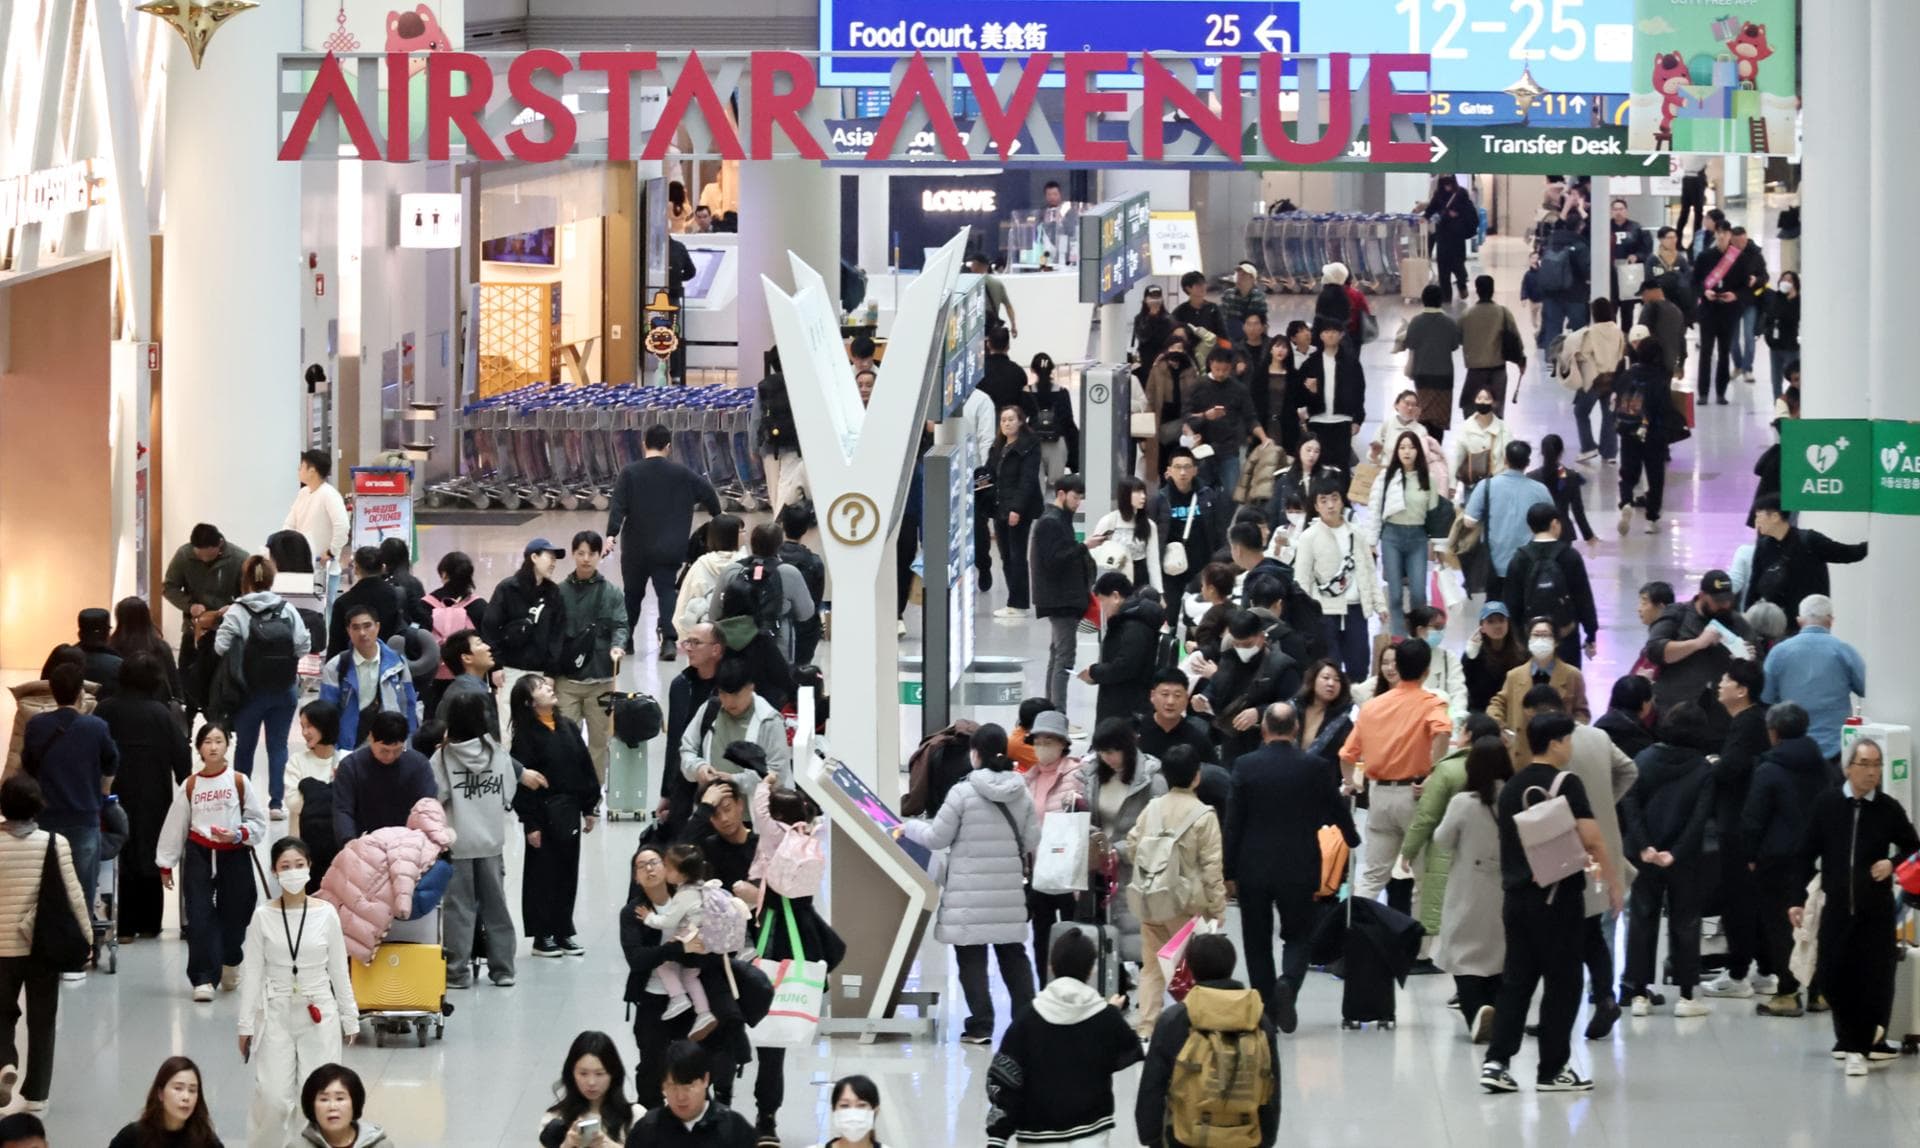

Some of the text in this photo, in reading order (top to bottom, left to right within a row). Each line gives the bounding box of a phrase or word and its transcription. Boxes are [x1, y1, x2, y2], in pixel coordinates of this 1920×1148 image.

[849, 20, 1047, 50] Food Court, 美食街
[1205, 13, 1241, 47] 25
[1395, 0, 1587, 61] 12-25
[278, 48, 1431, 164] AIRSTAR AVENUE
[1458, 101, 1494, 116] Gates
[832, 127, 878, 147] Asia
[1481, 134, 1621, 155] Transfer Desk
[922, 189, 997, 212] LOEWE
[1801, 478, 1844, 494] AED
[194, 788, 233, 805] DREAMS
